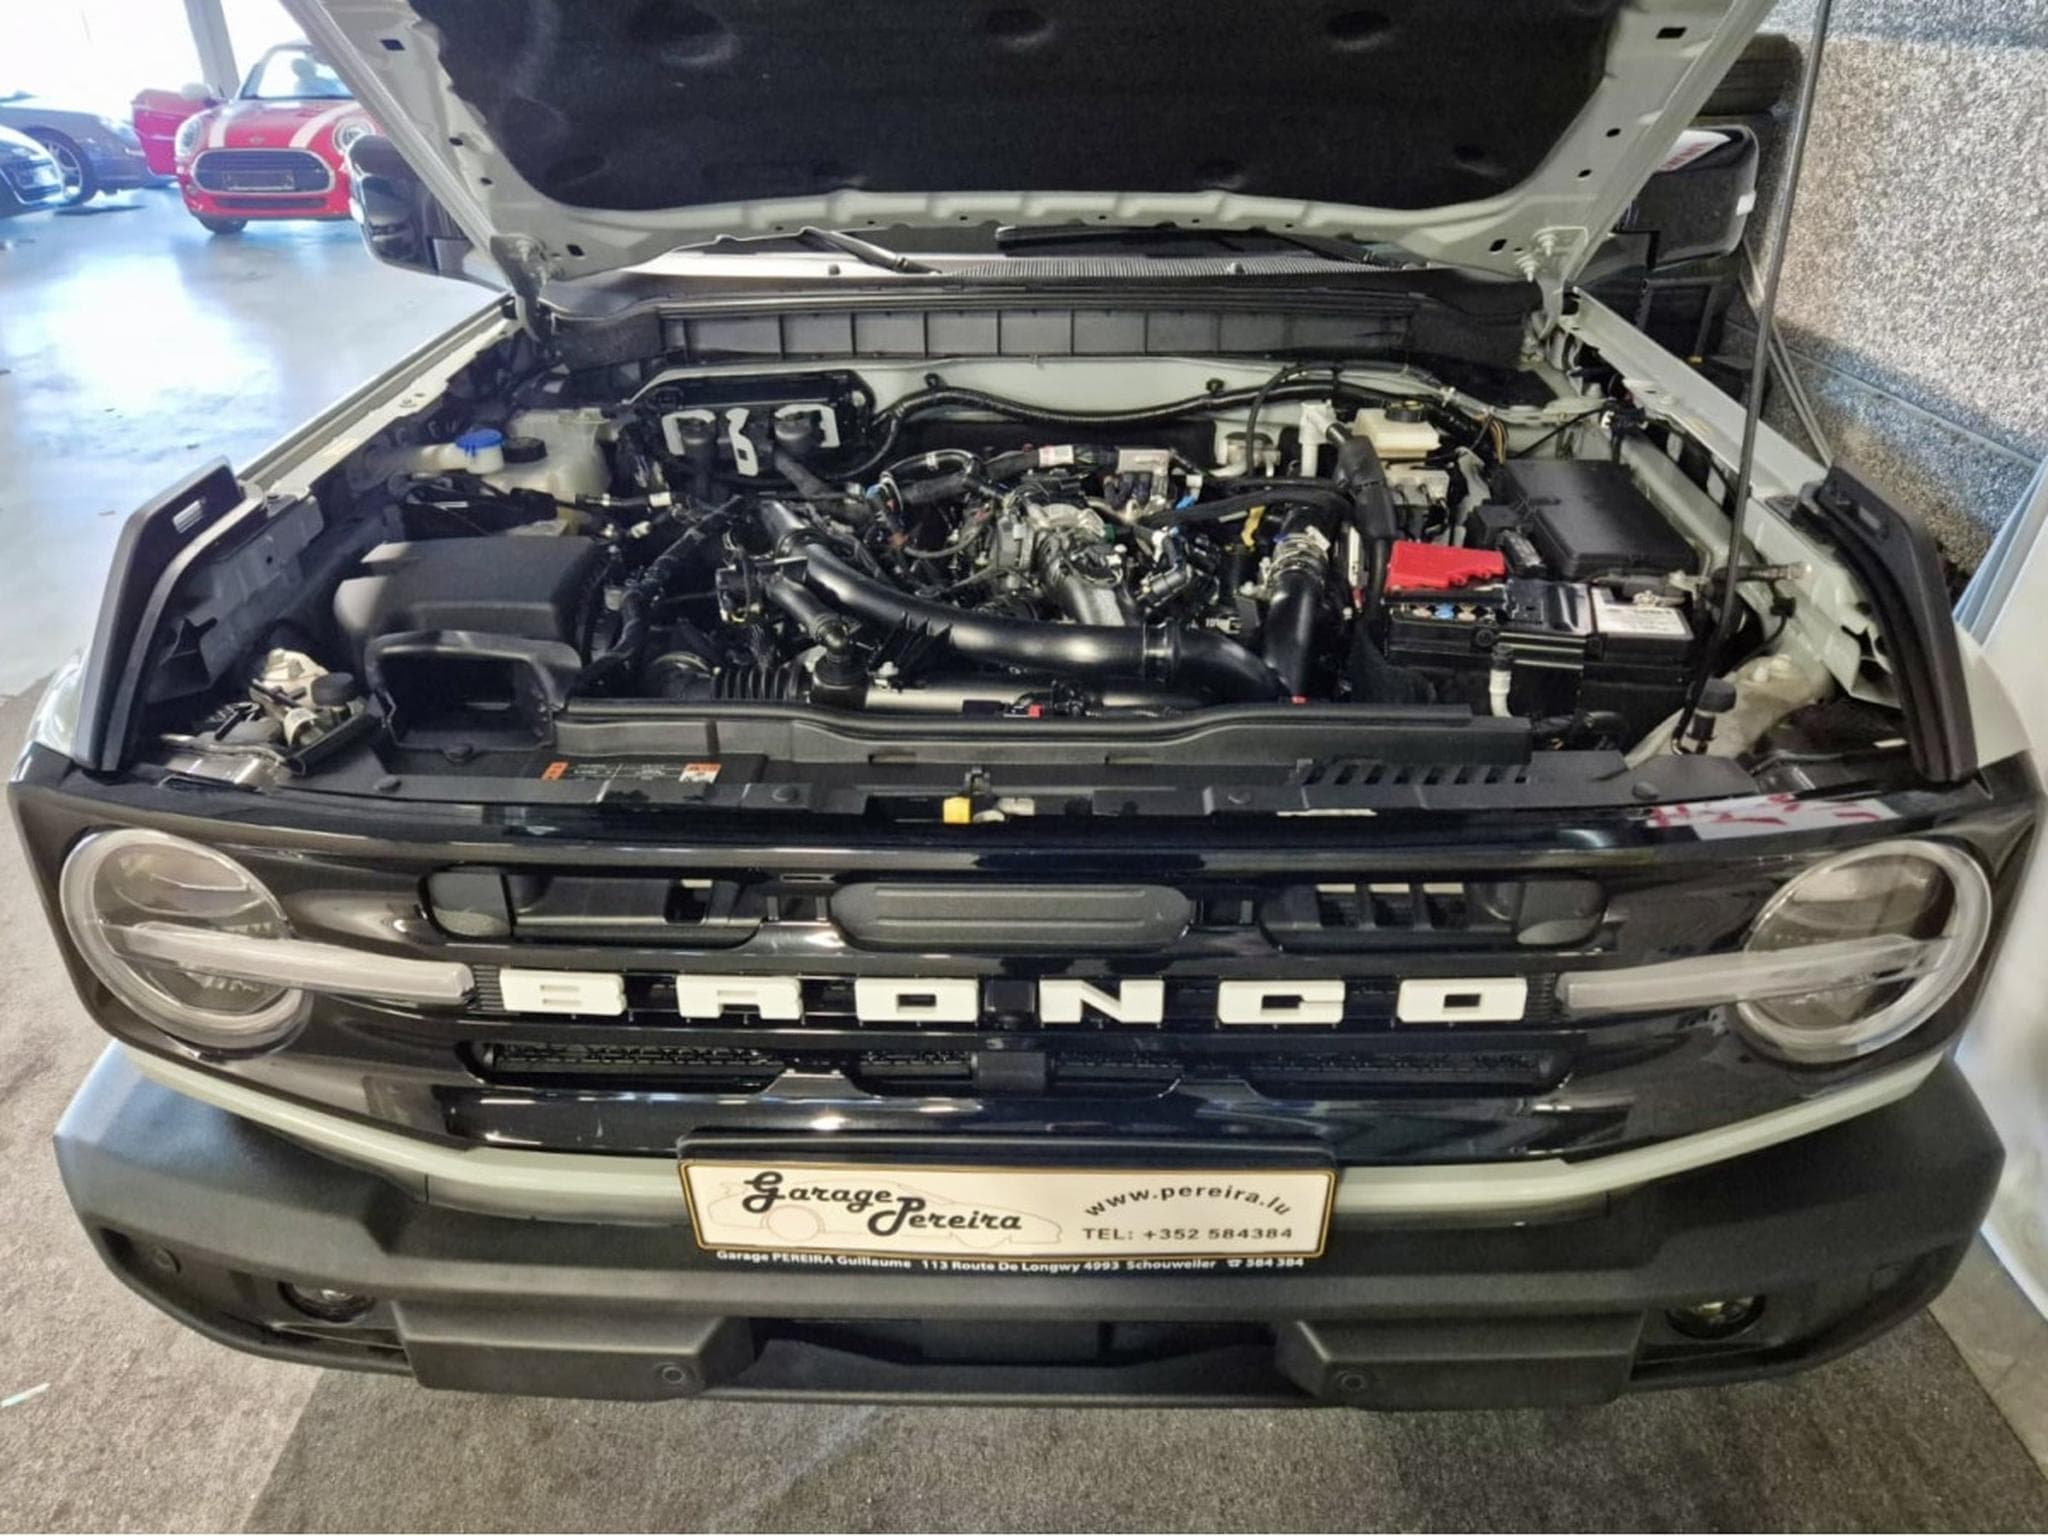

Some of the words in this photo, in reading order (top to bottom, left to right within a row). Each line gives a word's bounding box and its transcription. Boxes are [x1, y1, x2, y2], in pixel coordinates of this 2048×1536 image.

[500, 967, 1528, 1026] BRONCO
[742, 1171, 893, 1214] Garage
[1085, 1185, 1291, 1217] www.pereira.lu
[867, 1197, 1022, 1237] Pereira
[1083, 1227, 1134, 1241] TEL:
[1144, 1227, 1200, 1241] +352
[1208, 1227, 1293, 1241] 584384
[716, 1250, 770, 1264] Garage
[772, 1252, 834, 1265] PEREIRA
[837, 1257, 912, 1269] Guillaume
[921, 1259, 948, 1271] 113
[952, 1260, 995, 1271] Route
[998, 1261, 1018, 1272] De
[1021, 1262, 1080, 1274] Longwy
[1083, 1261, 1120, 1271] 4993
[1126, 1260, 1217, 1270] Schouweiler
